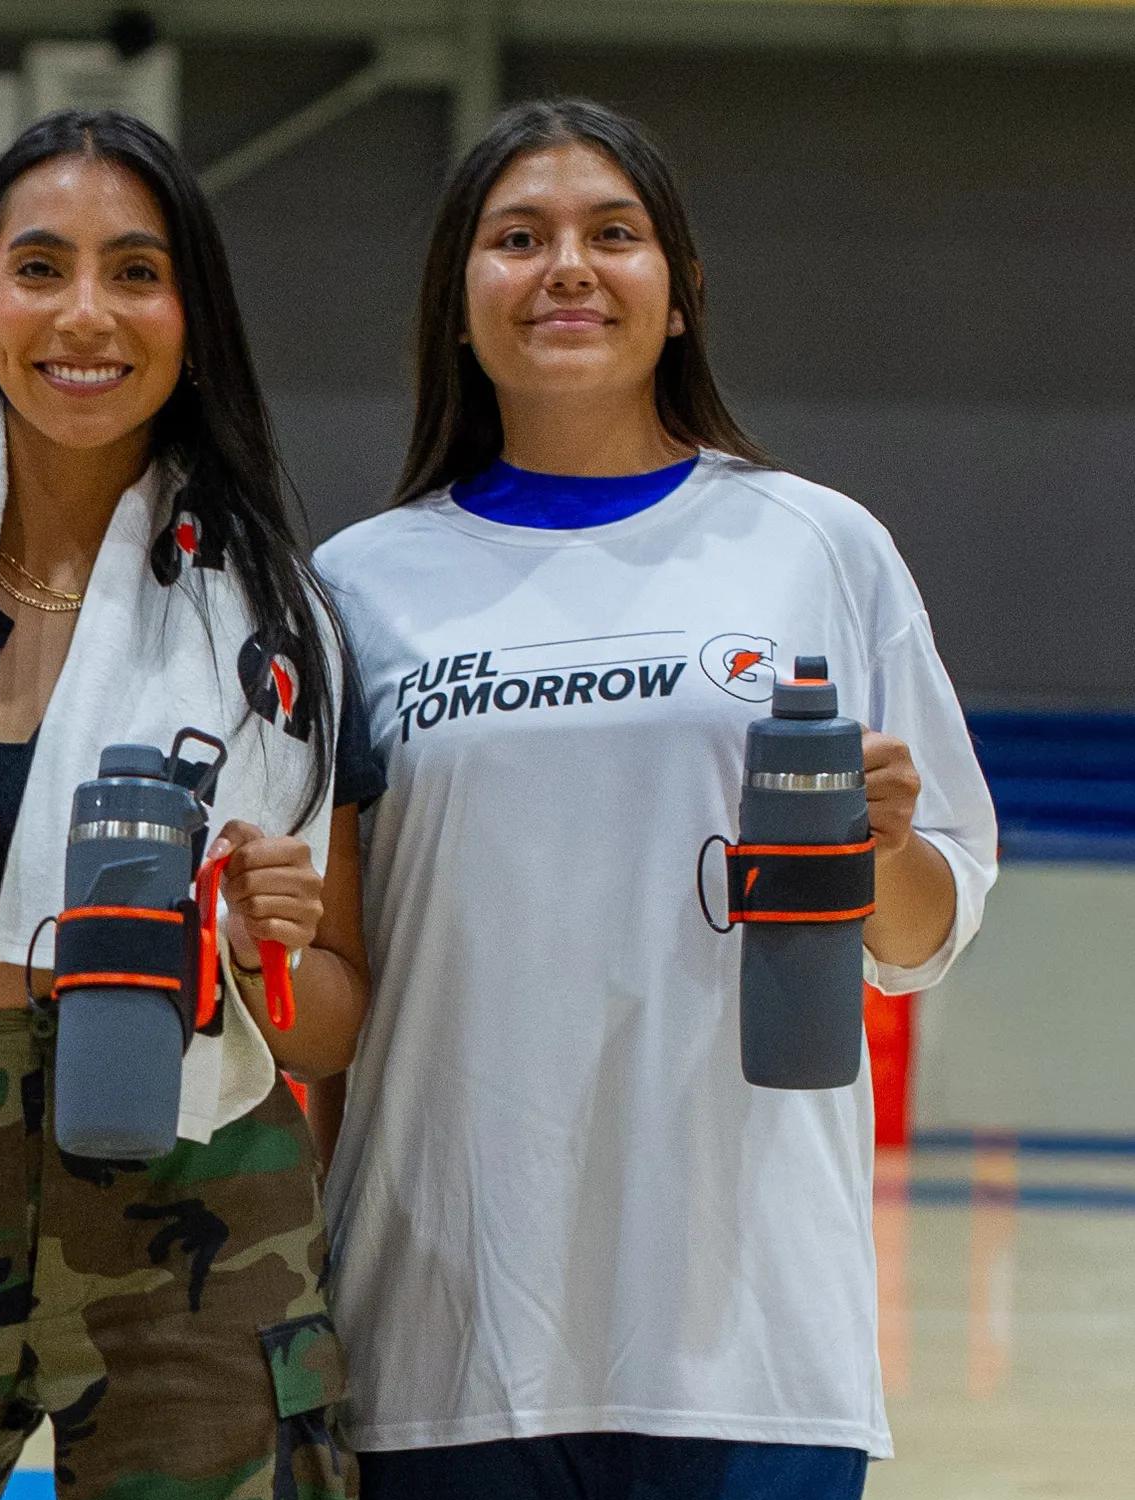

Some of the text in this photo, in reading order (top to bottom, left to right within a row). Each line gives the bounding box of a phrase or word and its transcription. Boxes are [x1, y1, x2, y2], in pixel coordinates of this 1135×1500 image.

[395, 650, 499, 709] FUEL
[397, 662, 687, 744] TOMORROW
[699, 632, 778, 703] G
